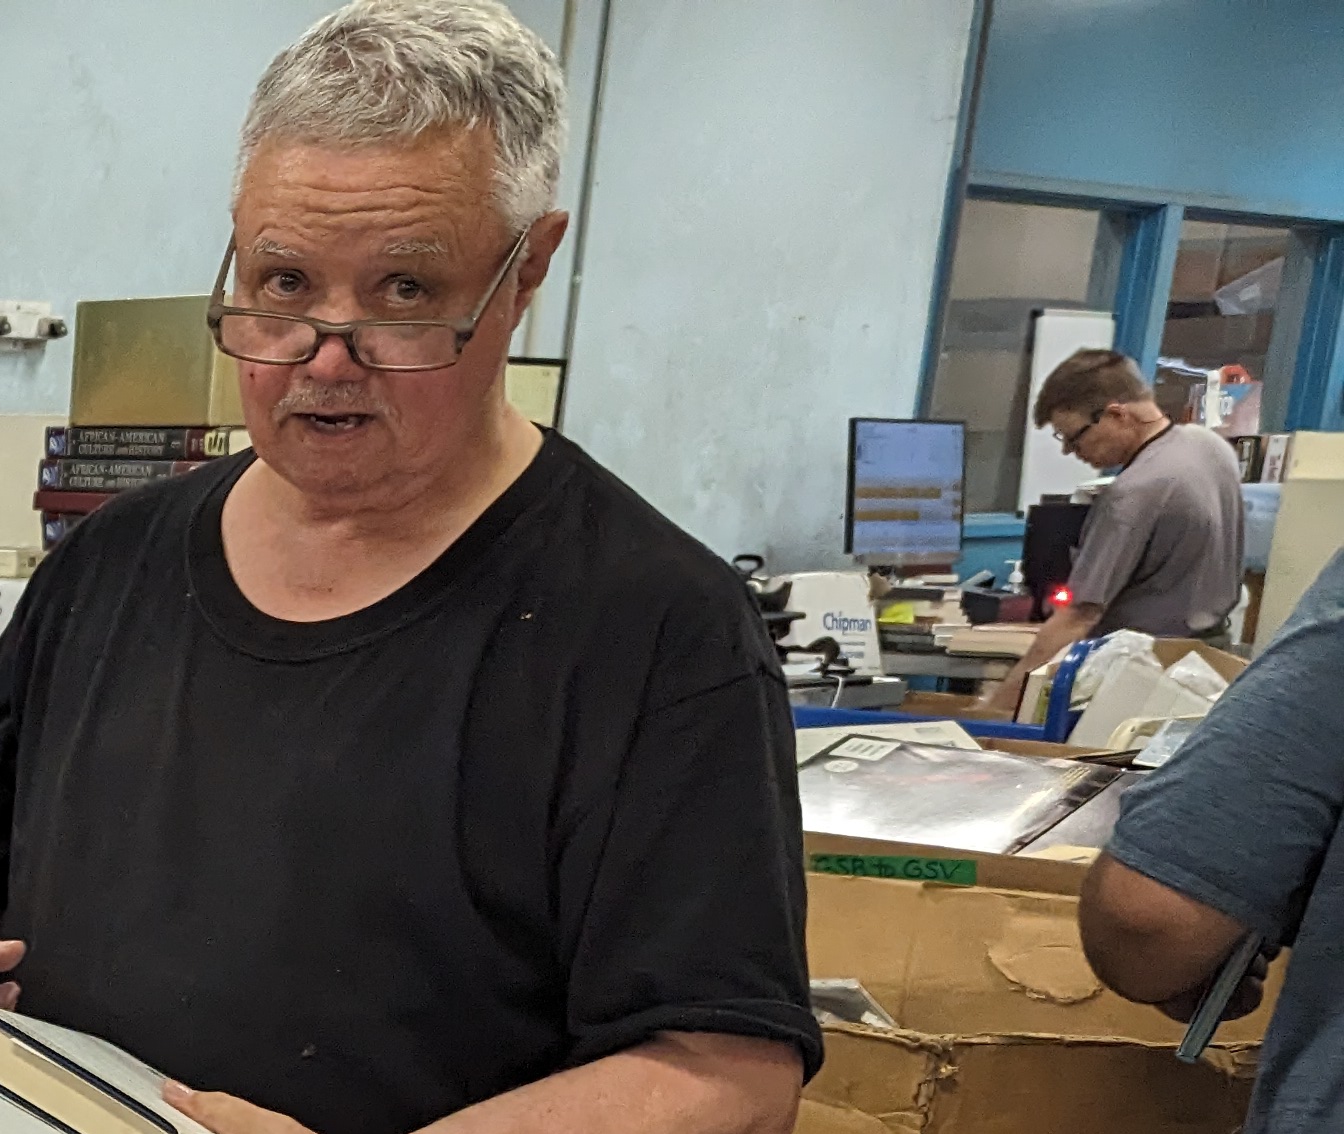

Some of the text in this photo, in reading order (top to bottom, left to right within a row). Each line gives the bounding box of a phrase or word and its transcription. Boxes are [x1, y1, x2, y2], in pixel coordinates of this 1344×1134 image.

[79, 430, 166, 444] AFRICAN-AMERICAN
[78, 444, 165, 456] CULTURE HISTORY
[70, 464, 152, 476] AFRICAN-AMERICAN
[69, 476, 103, 488] CULTURE
[823, 611, 872, 636] Chipman
